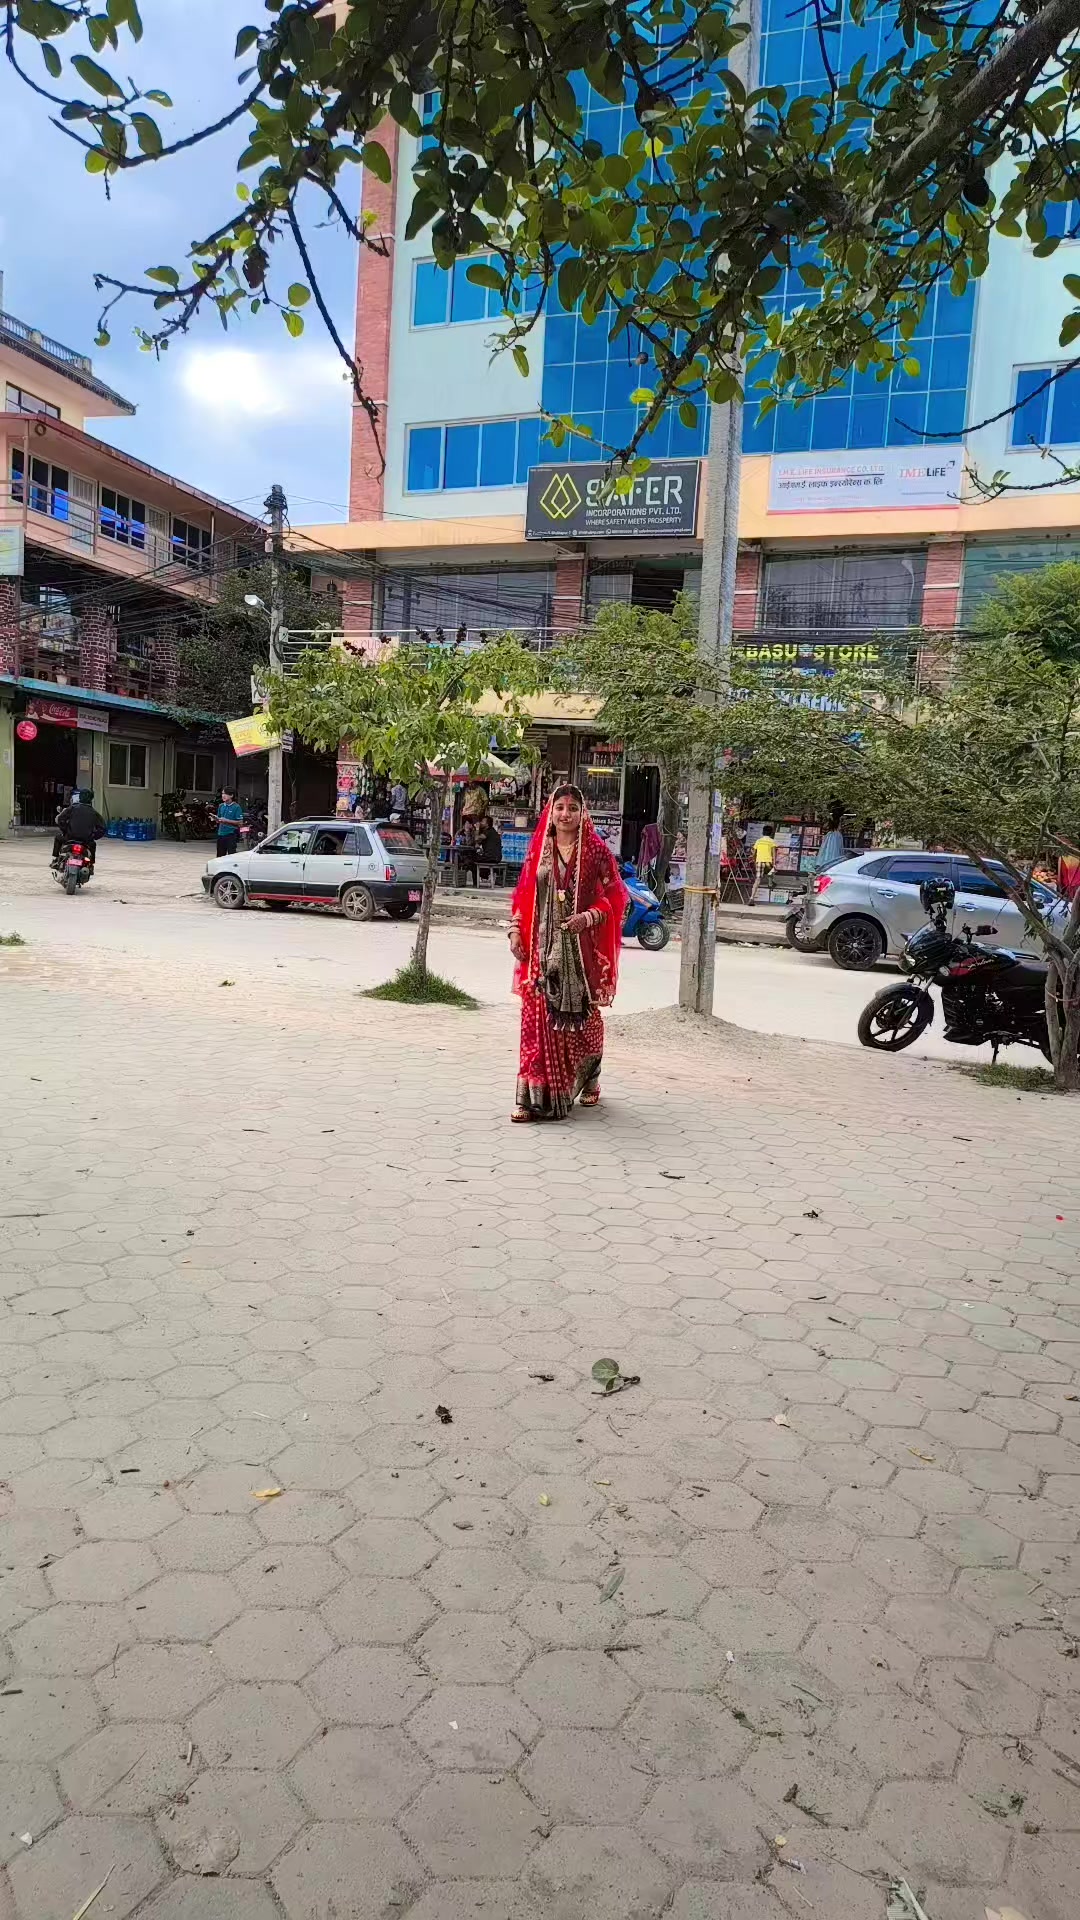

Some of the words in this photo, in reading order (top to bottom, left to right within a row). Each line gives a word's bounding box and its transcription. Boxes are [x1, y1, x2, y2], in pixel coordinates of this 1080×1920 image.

[814, 466, 855, 475] INSURANCE
[586, 475, 683, 507] SAFER
[585, 508, 647, 517] INCORPORATIONS
[648, 507, 665, 515] PVT.
[665, 506, 682, 515] LTD.
[585, 518, 605, 526] WHERE
[605, 518, 627, 526] SAFETY
[627, 517, 647, 525] MEETS
[647, 516, 682, 524] PROSPERITY
